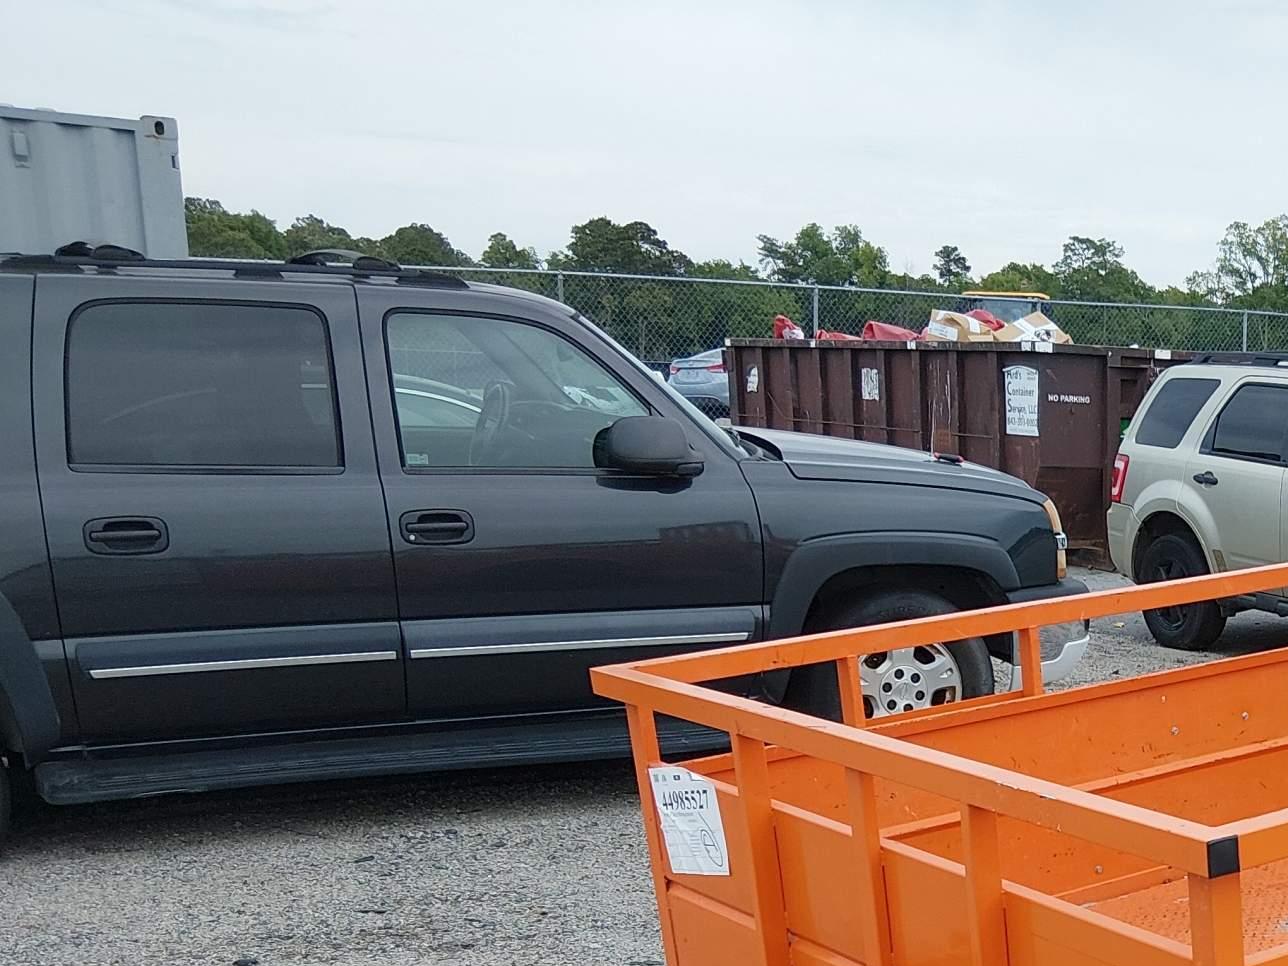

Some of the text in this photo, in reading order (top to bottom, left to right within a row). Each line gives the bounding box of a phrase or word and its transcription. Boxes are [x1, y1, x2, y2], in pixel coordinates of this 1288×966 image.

[1048, 393, 1091, 404] NO PARKING
[662, 790, 709, 810] 44985527
